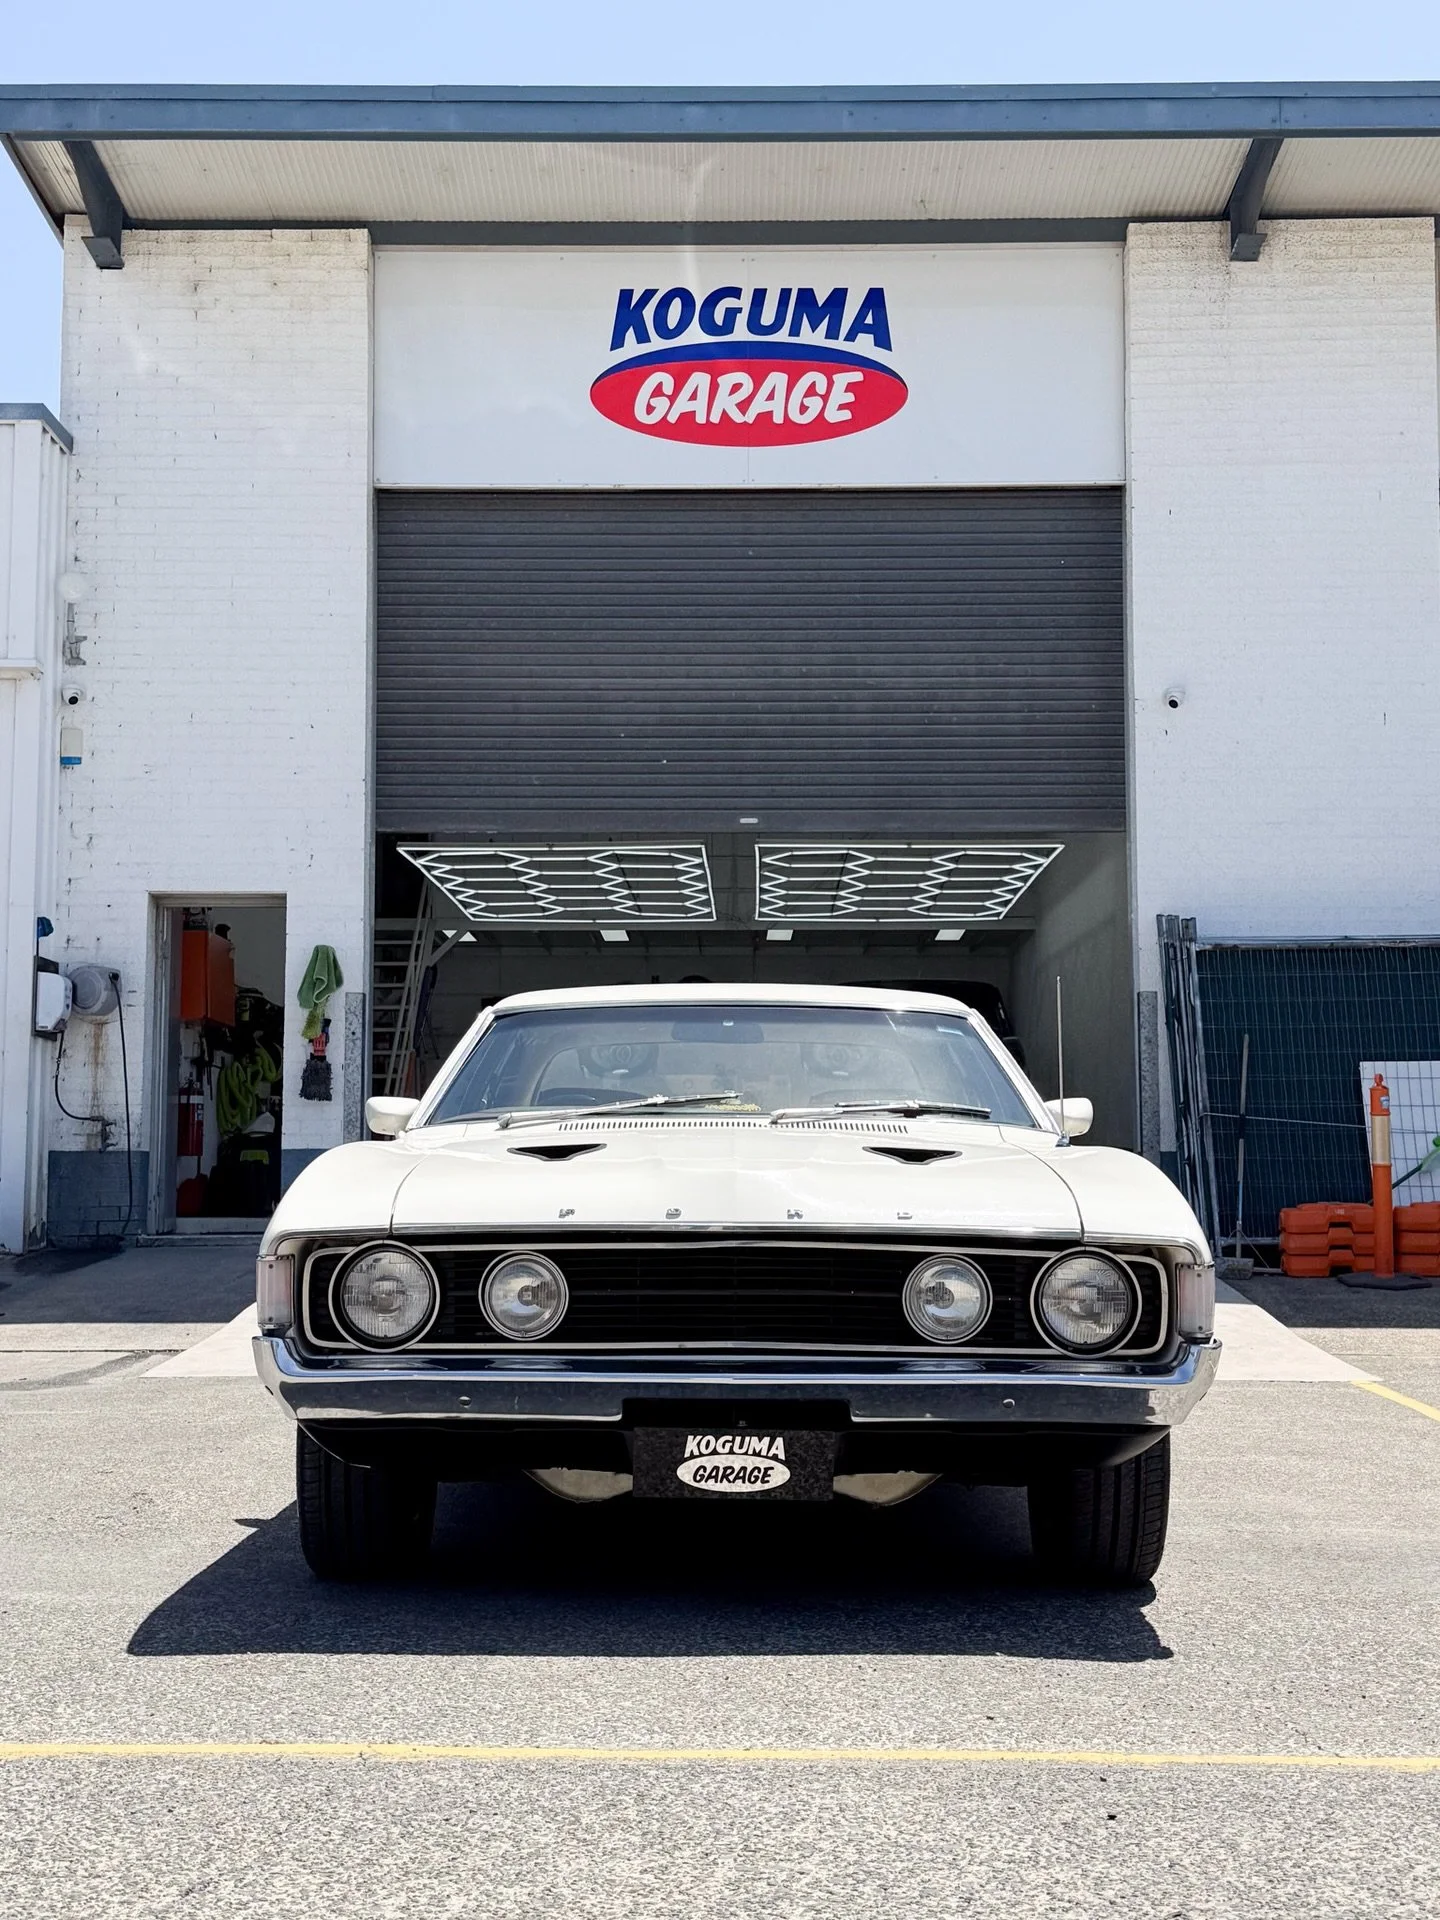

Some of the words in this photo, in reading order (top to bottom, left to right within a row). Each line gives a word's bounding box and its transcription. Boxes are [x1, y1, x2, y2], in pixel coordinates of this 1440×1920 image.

[610, 286, 892, 352] KOGUMA
[633, 371, 864, 424] GARAGE
[684, 1435, 786, 1461] KOGUMA
[692, 1465, 775, 1484] GARAGE
